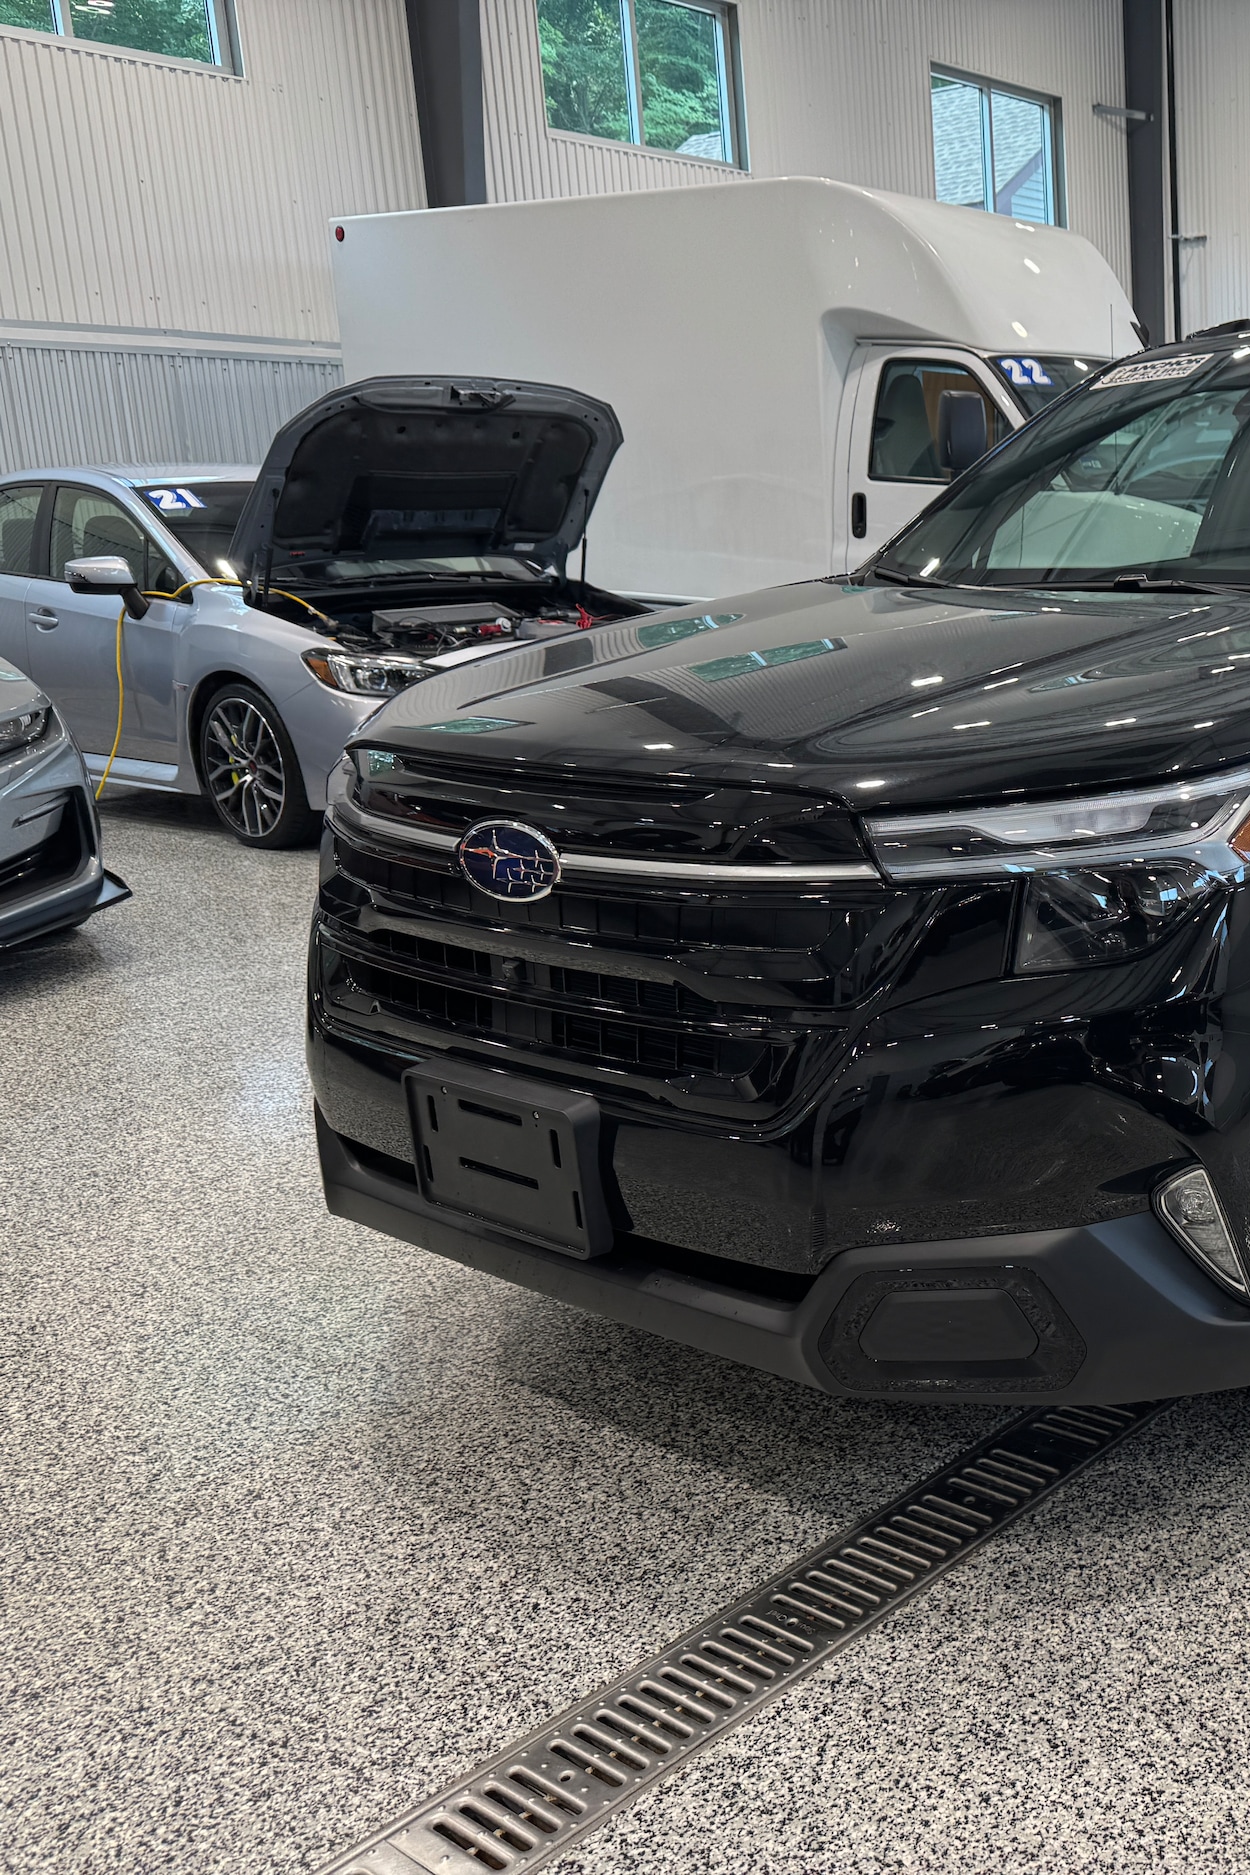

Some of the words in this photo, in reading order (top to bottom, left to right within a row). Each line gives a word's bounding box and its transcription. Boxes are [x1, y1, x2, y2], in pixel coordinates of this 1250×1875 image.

[1001, 358, 1052, 384] 22
[1125, 356, 1207, 373] ANCHOR
[148, 487, 206, 509] 21
